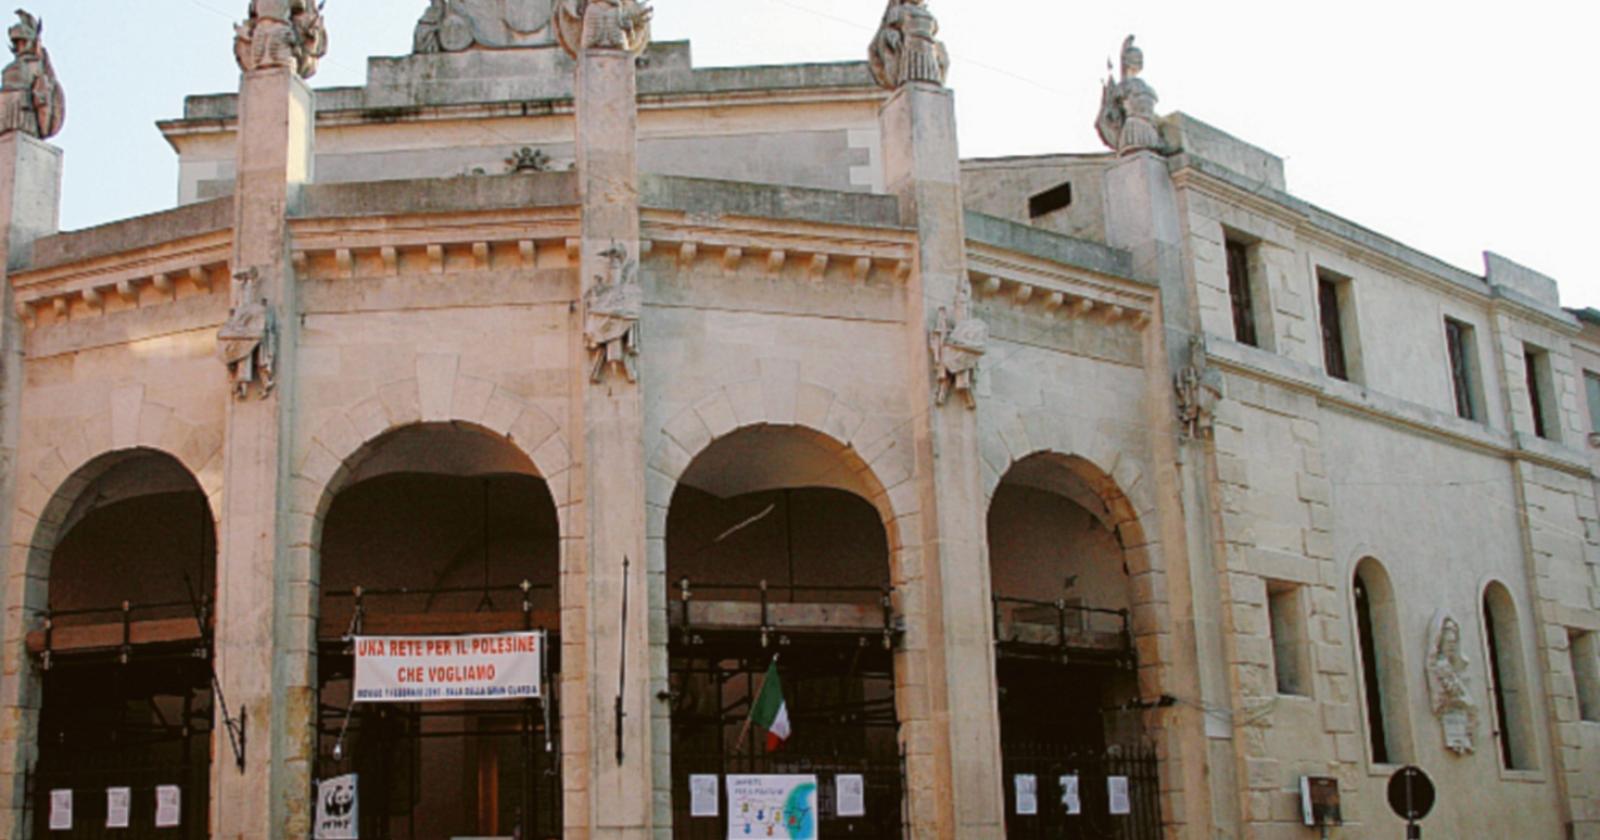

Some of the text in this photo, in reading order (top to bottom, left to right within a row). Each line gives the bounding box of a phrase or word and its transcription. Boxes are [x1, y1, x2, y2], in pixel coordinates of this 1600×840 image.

[359, 636, 535, 656] UNA RETE PER IL POLESINE
[398, 664, 496, 683] CHE VOGLIAMO
